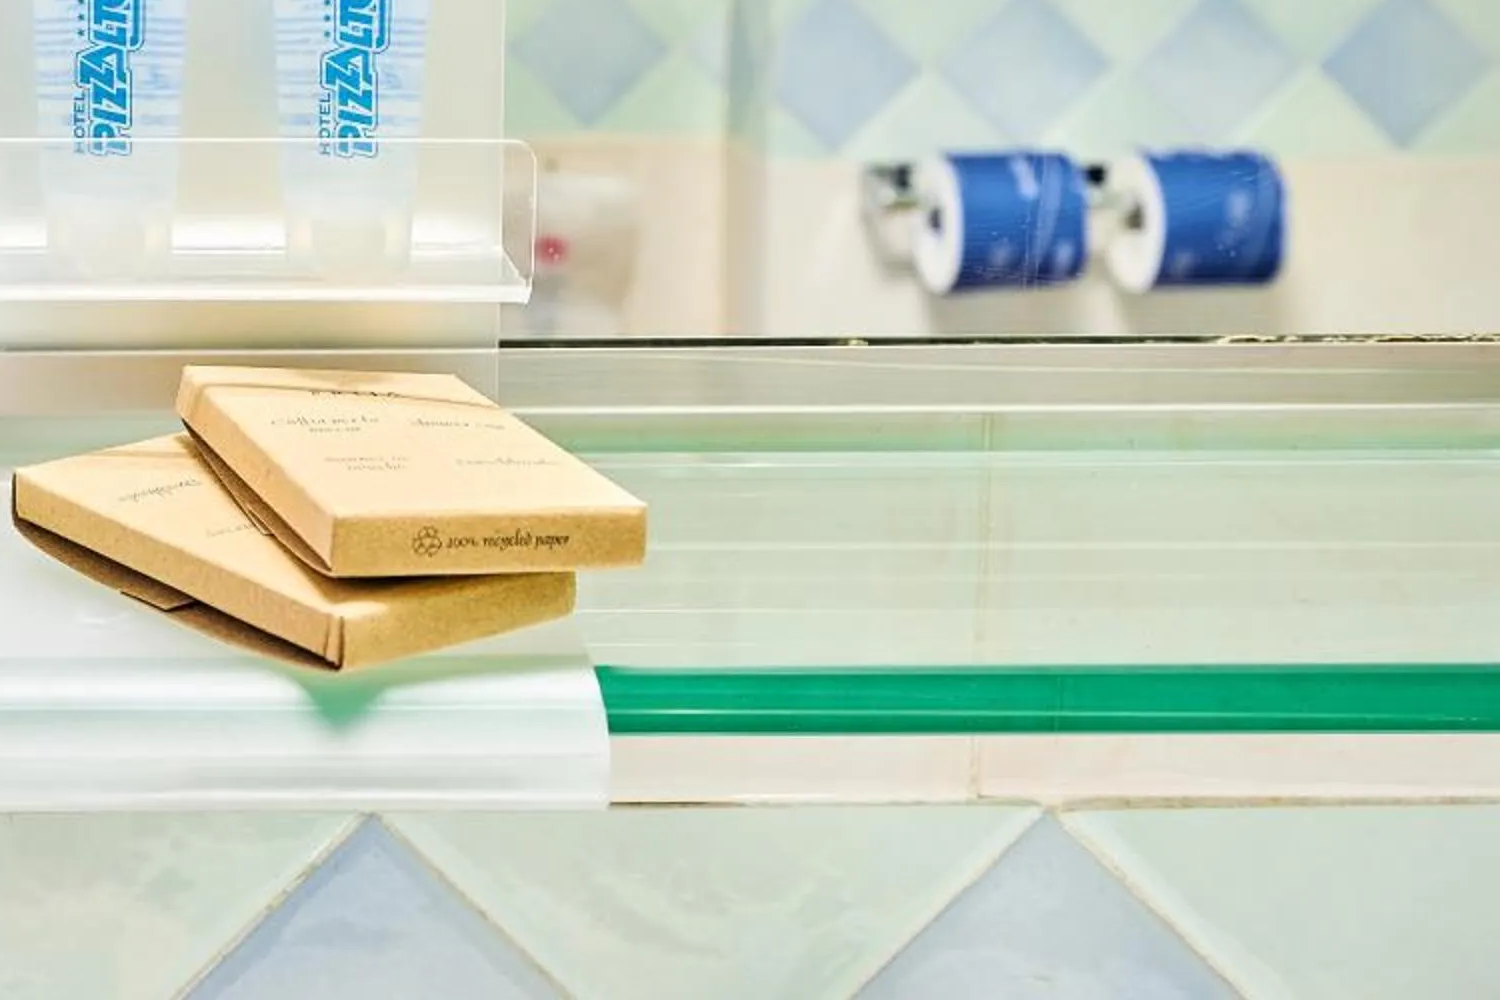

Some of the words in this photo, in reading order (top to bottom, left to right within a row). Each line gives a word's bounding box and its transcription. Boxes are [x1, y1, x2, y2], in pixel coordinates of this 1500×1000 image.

[73, 90, 86, 154] HOTEL
[319, 92, 332, 155] HOTEL
[483, 528, 532, 551] recycled
[535, 535, 571, 551] paper
